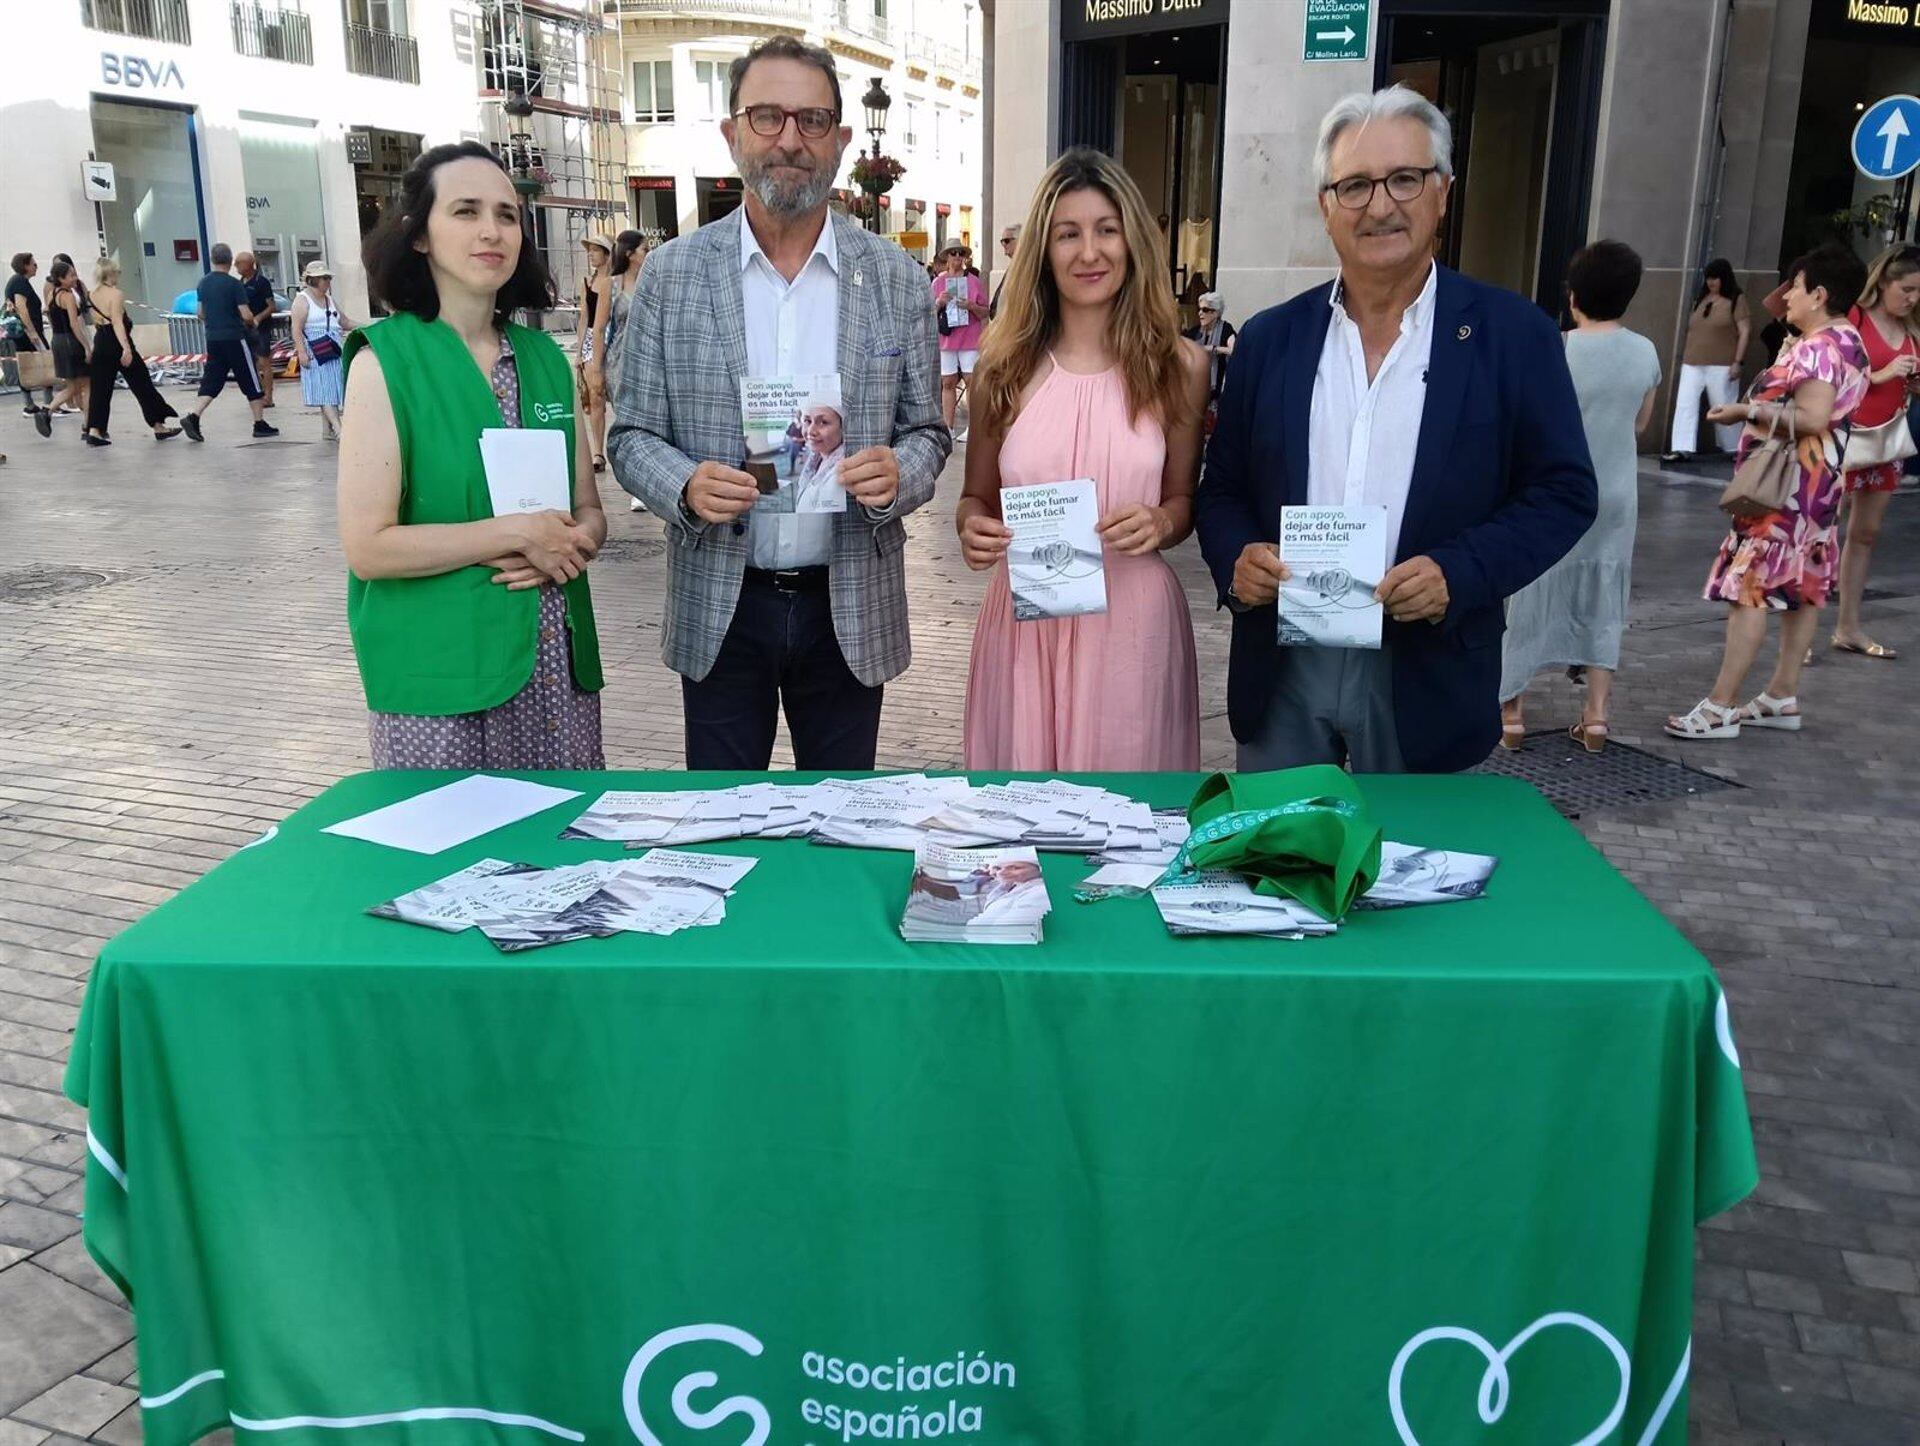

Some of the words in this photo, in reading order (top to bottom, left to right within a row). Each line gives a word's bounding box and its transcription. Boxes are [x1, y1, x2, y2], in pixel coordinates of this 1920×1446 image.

[1086, 0, 1153, 22] Massimo
[1848, 0, 1909, 25] Massimo
[101, 51, 185, 90] BBVA
[747, 382, 764, 390] Con
[747, 391, 769, 400] dejar
[771, 391, 783, 399] de
[784, 389, 811, 398] fumar
[760, 399, 778, 408] más
[779, 399, 799, 407] fácil
[1004, 490, 1025, 501] Con
[1006, 500, 1032, 513] dejar
[1033, 498, 1048, 508] de
[1048, 495, 1080, 505] fumar
[1020, 511, 1042, 520] más
[1043, 507, 1066, 517] fácil
[1285, 510, 1308, 519] Con
[1284, 521, 1313, 532] dejar
[1315, 521, 1331, 531] de
[1332, 520, 1367, 531] fumar
[1299, 531, 1324, 541] más
[1325, 531, 1351, 542] fácil
[802, 1351, 1016, 1392] asociación
[801, 1398, 982, 1443] española
